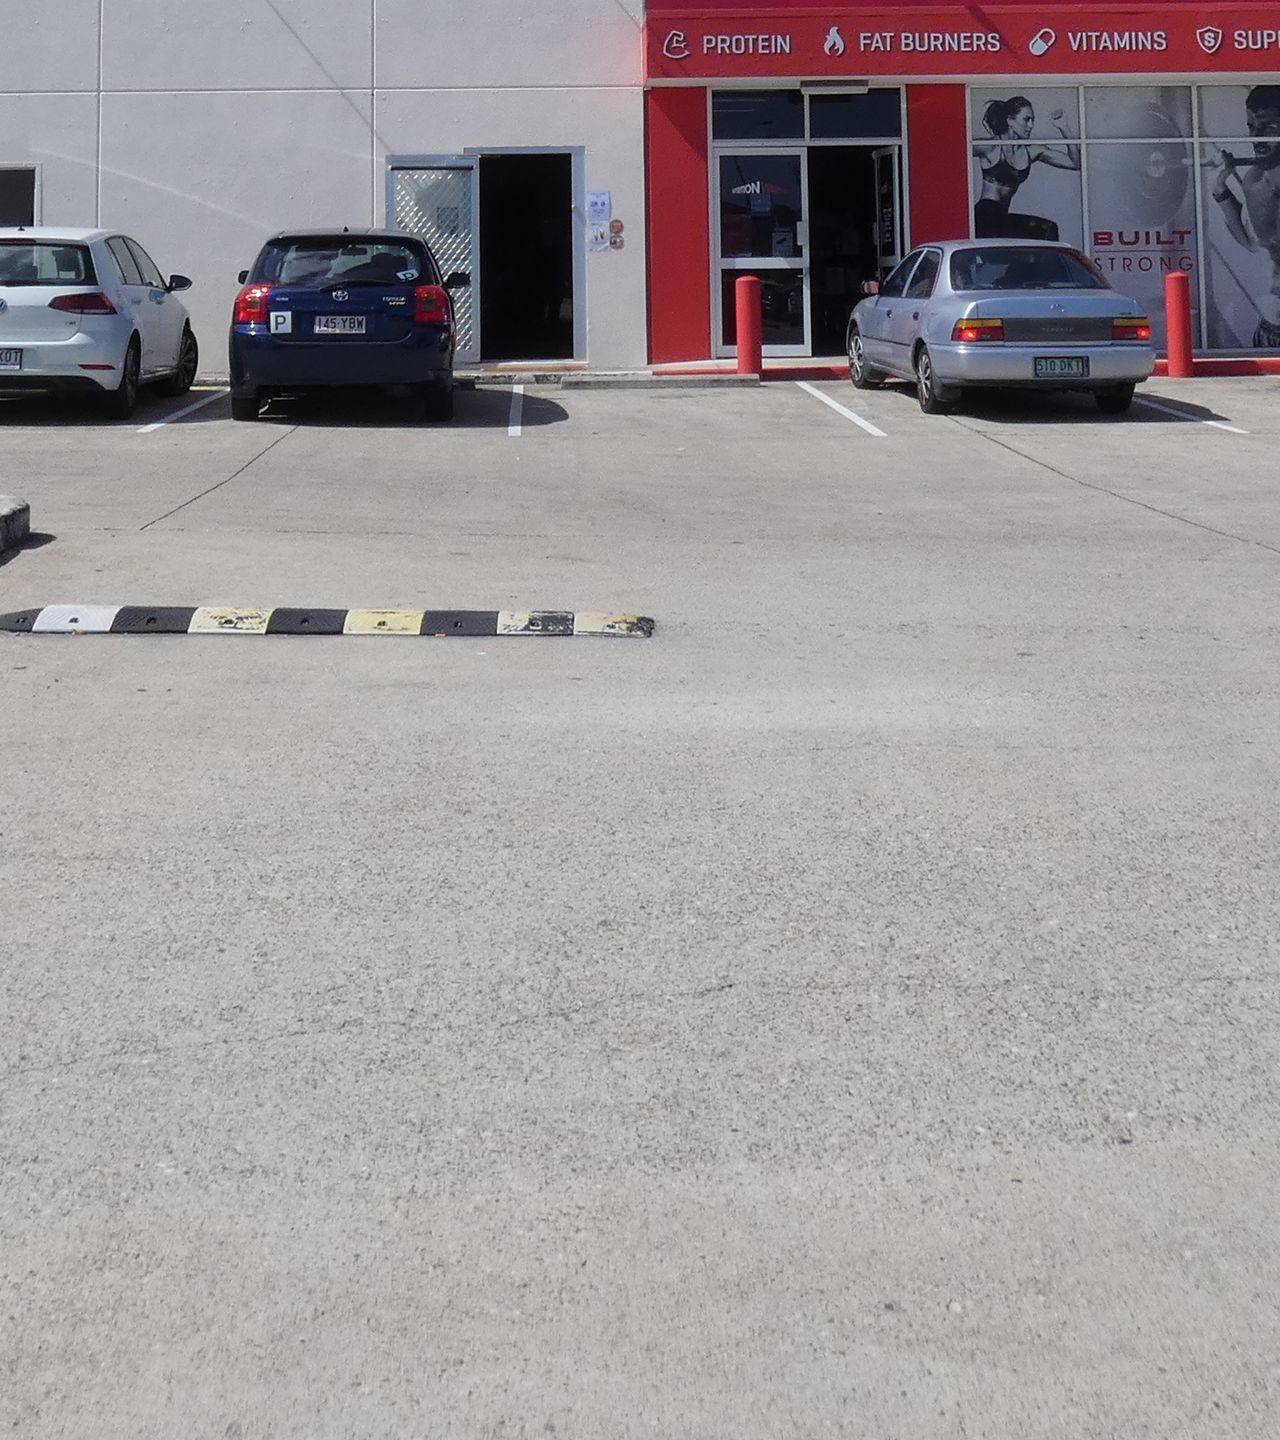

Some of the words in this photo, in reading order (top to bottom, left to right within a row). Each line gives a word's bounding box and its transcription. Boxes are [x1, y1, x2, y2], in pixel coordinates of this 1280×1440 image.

[703, 35, 792, 55] PROTEIN
[860, 32, 897, 53] FAT
[901, 32, 1001, 53] BURNERS
[1067, 30, 1167, 52] VITAMINS
[1093, 230, 1192, 246] BUILT
[1095, 256, 1194, 271] STRONG
[275, 315, 286, 331] P
